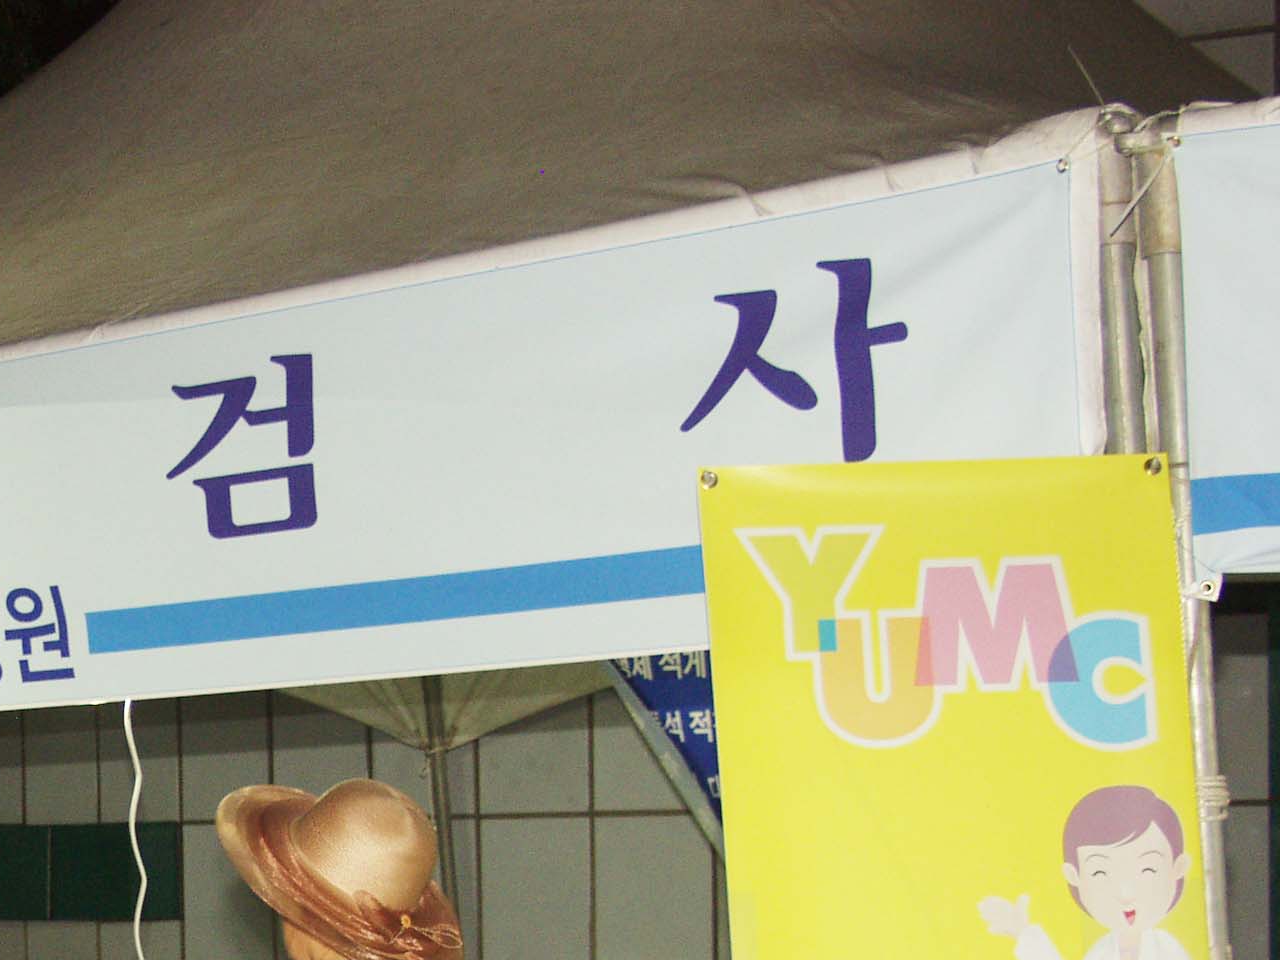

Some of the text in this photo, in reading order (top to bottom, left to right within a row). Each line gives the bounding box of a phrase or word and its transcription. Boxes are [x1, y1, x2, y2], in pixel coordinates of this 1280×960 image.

[166, 353, 318, 540] 검
[679, 258, 908, 463] 사
[736, 524, 1157, 752] YUMC
